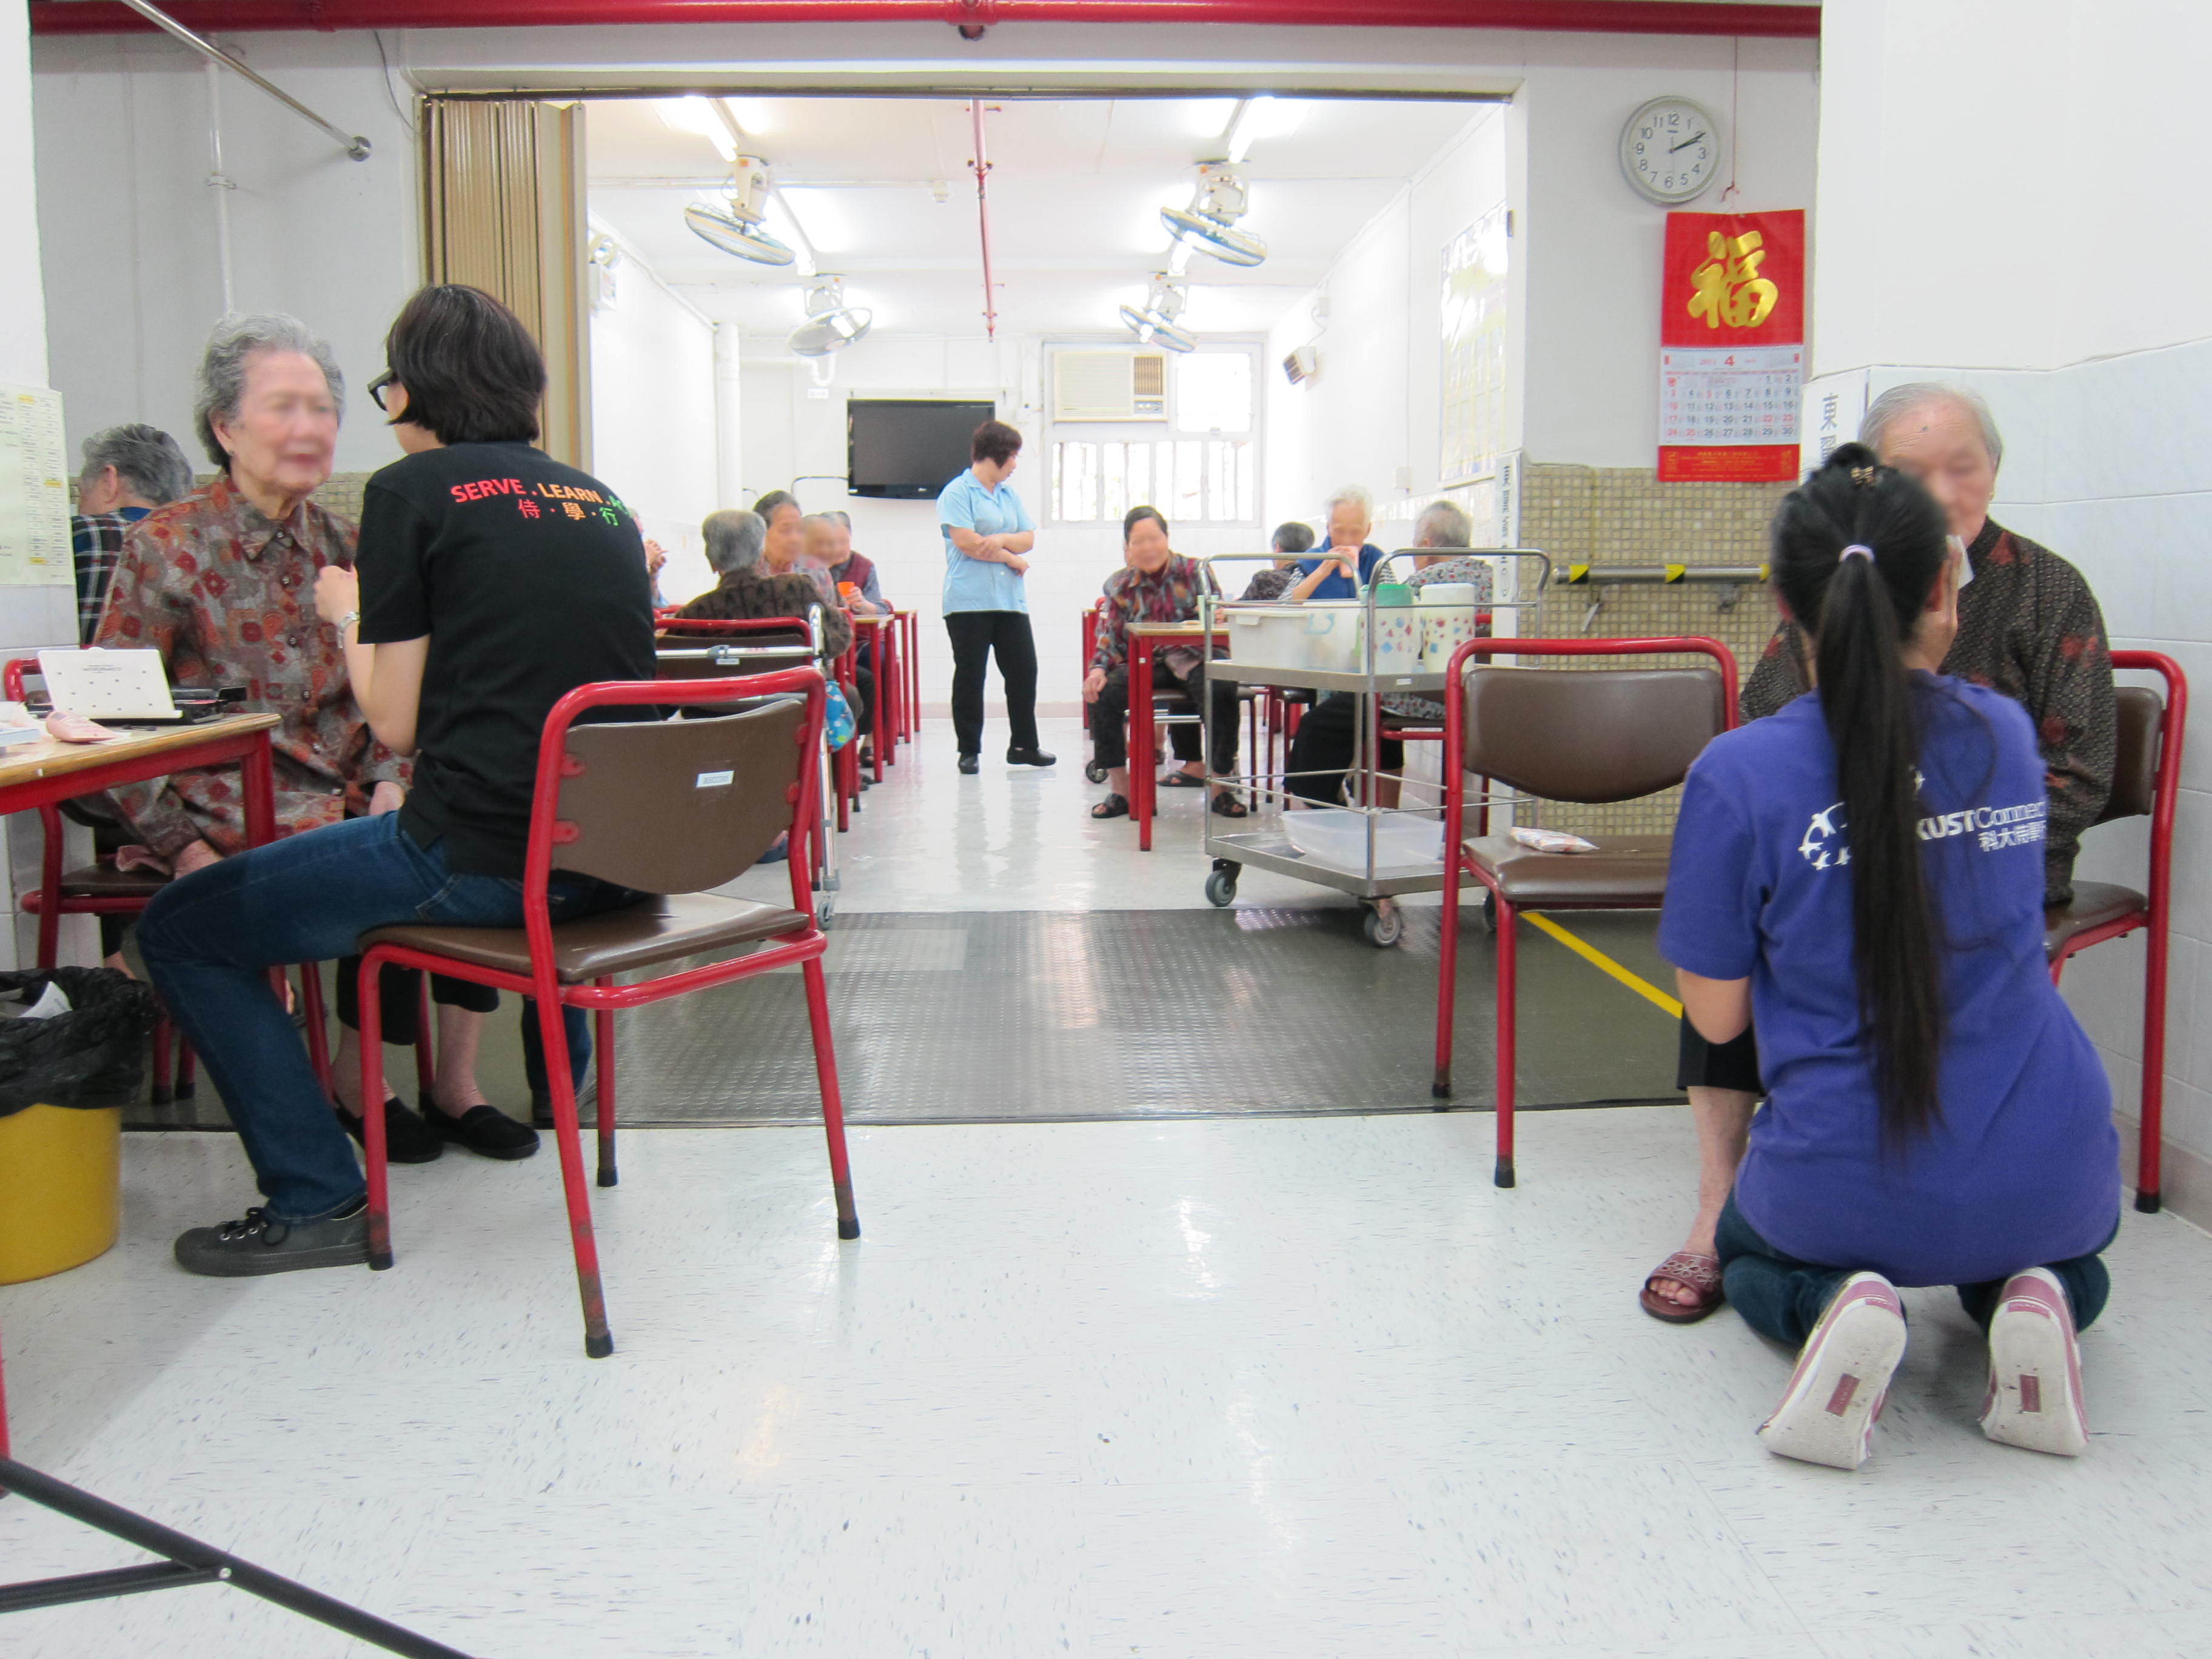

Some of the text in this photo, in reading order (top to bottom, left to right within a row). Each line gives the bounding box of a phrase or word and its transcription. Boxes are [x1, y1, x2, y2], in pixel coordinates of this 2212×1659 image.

[1654, 116, 1663, 128] 11
[1668, 112, 1680, 126] 12
[1687, 117, 1694, 130] 1
[1640, 127, 1653, 139] 10
[1635, 142, 1645, 155] 9
[1698, 147, 1707, 159] 3
[1640, 158, 1648, 171] 8
[1692, 163, 1700, 174] 4
[1650, 170, 1659, 184] 7
[1664, 176, 1674, 189] 6
[1681, 173, 1689, 186] 5
[1687, 230, 1780, 329] 福
[1724, 355, 1735, 366] 4
